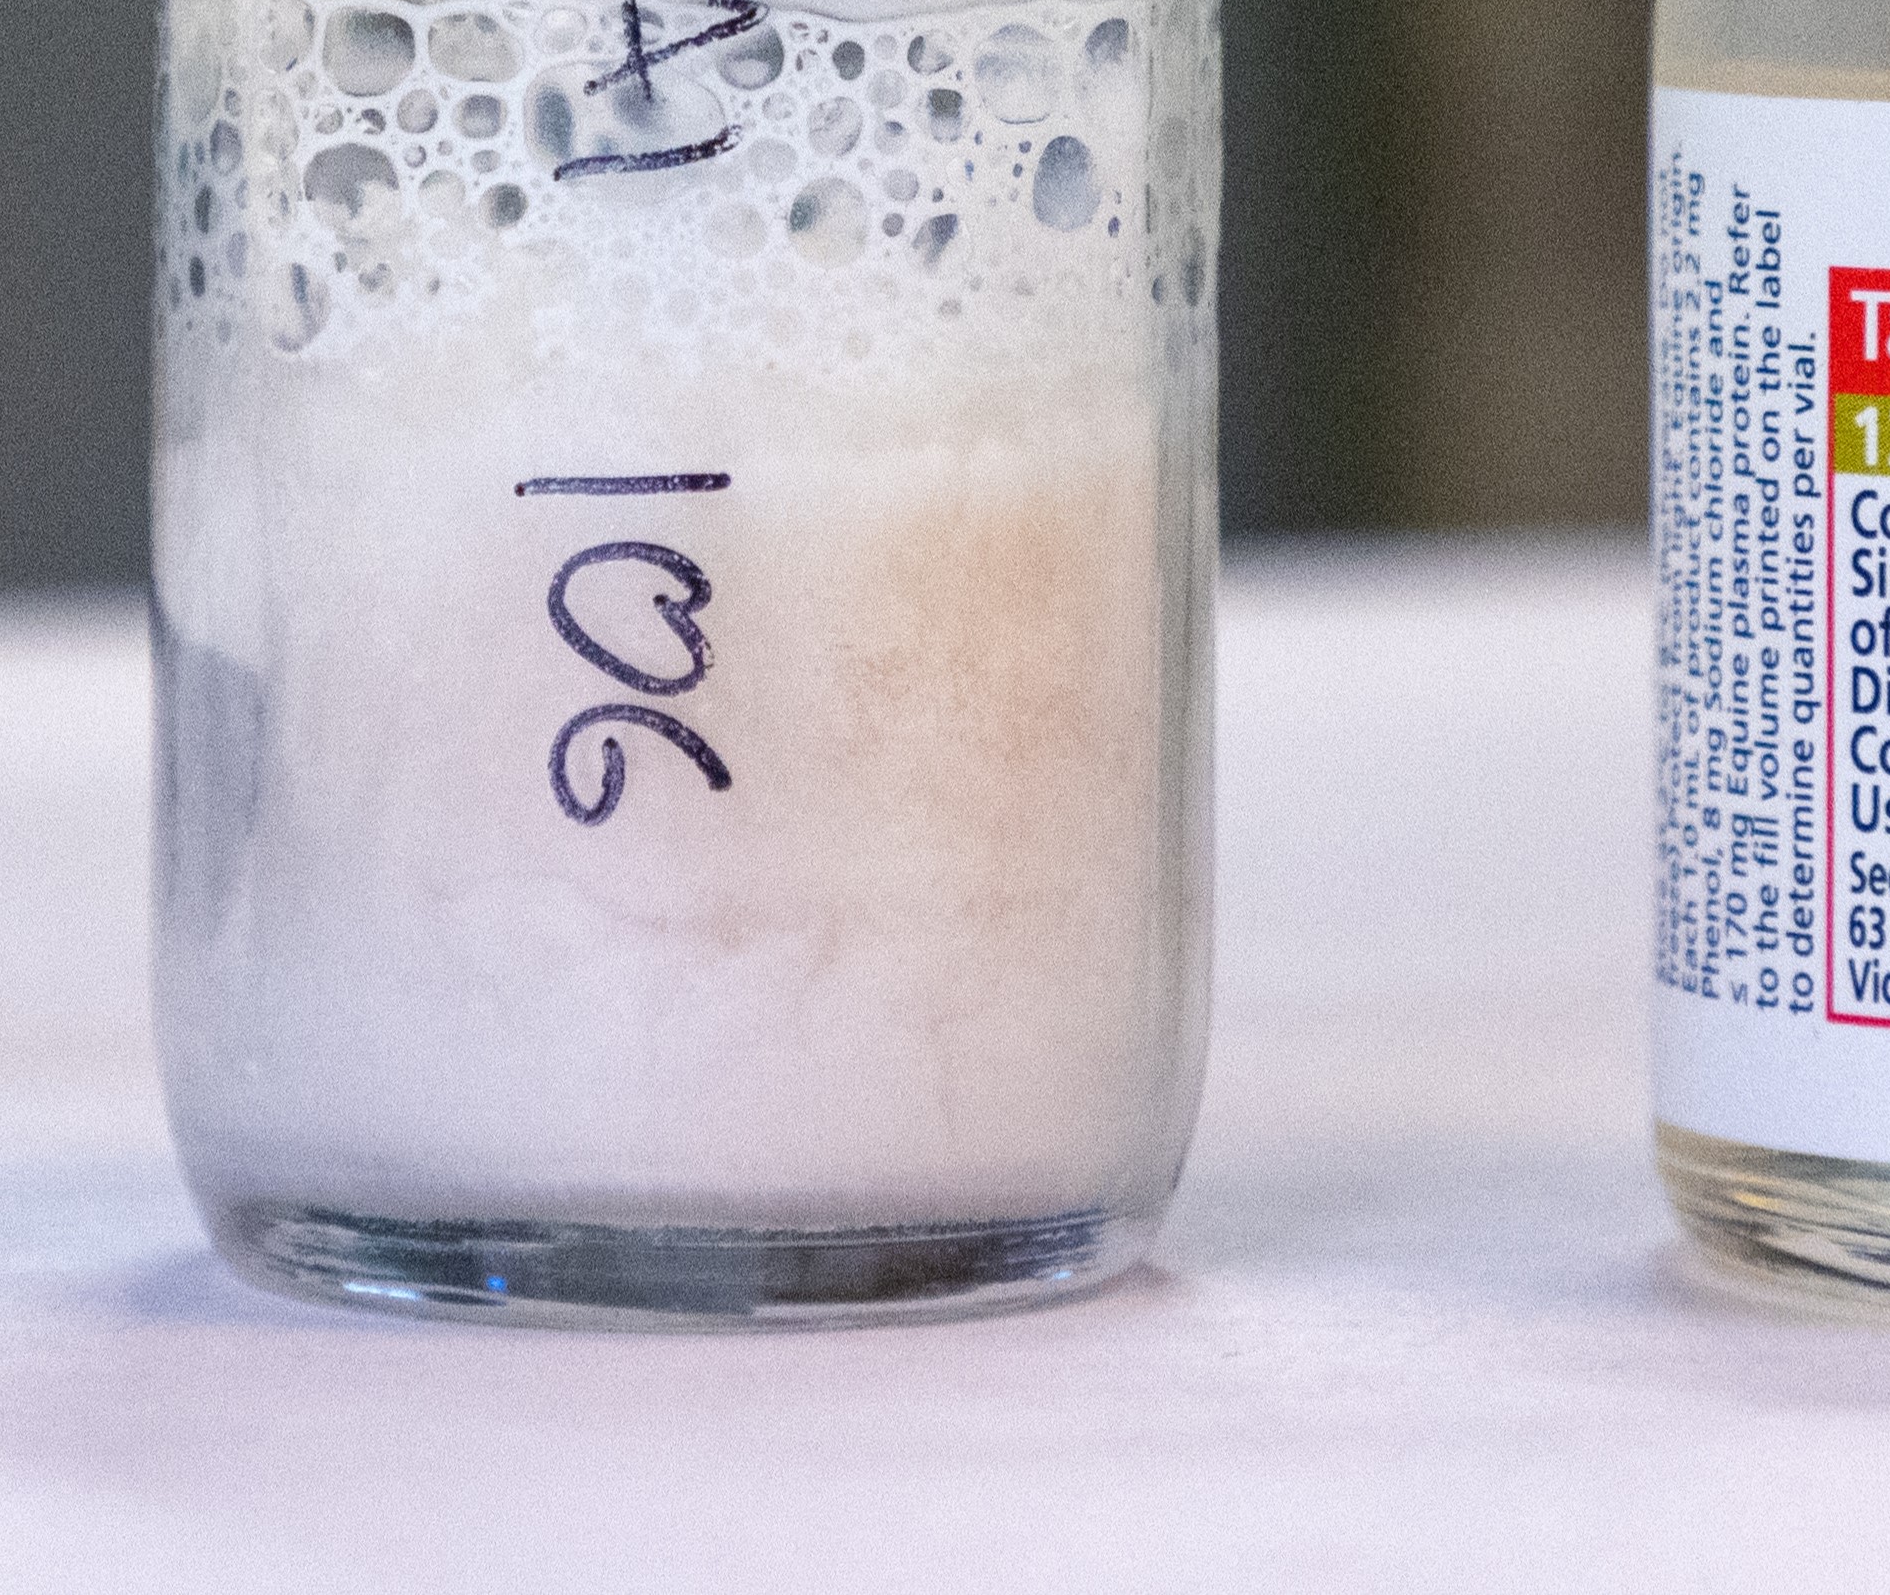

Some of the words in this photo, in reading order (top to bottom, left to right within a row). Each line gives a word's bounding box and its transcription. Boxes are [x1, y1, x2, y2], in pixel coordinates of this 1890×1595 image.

[1688, 171, 1704, 236] mg
[1727, 183, 1750, 295] Refer
[1685, 252, 1701, 312] 2.2
[1755, 208, 1781, 309] label
[1705, 280, 1723, 358] and
[1728, 312, 1755, 477] protein.
[1756, 325, 1781, 395] the
[1787, 331, 1816, 413] vial.
[1686, 327, 1701, 501] contains
[1763, 410, 1781, 462] on
[1704, 372, 1723, 541] chloride
[1793, 427, 1821, 499] per
[1727, 492, 1755, 639] plasma
[1755, 477, 1786, 631] printed
[1684, 517, 1703, 677] product
[1704, 557, 1722, 711] Sodium
[1787, 513, 1821, 724] quantities
[515, 472, 734, 826] 106
[1683, 691, 1700, 734] of
[1727, 654, 1753, 796] Equine
[1754, 646, 1779, 800] volume
[1683, 750, 1699, 808] mL
[1707, 726, 1727, 791] mg
[1682, 824, 1699, 877] 1.0
[1702, 806, 1720, 830] 8
[1731, 813, 1754, 877] mg
[1752, 816, 1779, 868] fill
[1785, 739, 1815, 957] determine
[1681, 900, 1698, 993] Each
[1701, 848, 1723, 1000] Phenol,
[1726, 892, 1748, 960] 170
[1752, 883, 1779, 952] the
[1848, 904, 1886, 951] 63
[1755, 967, 1779, 1010] to
[1790, 971, 1814, 1014] to
